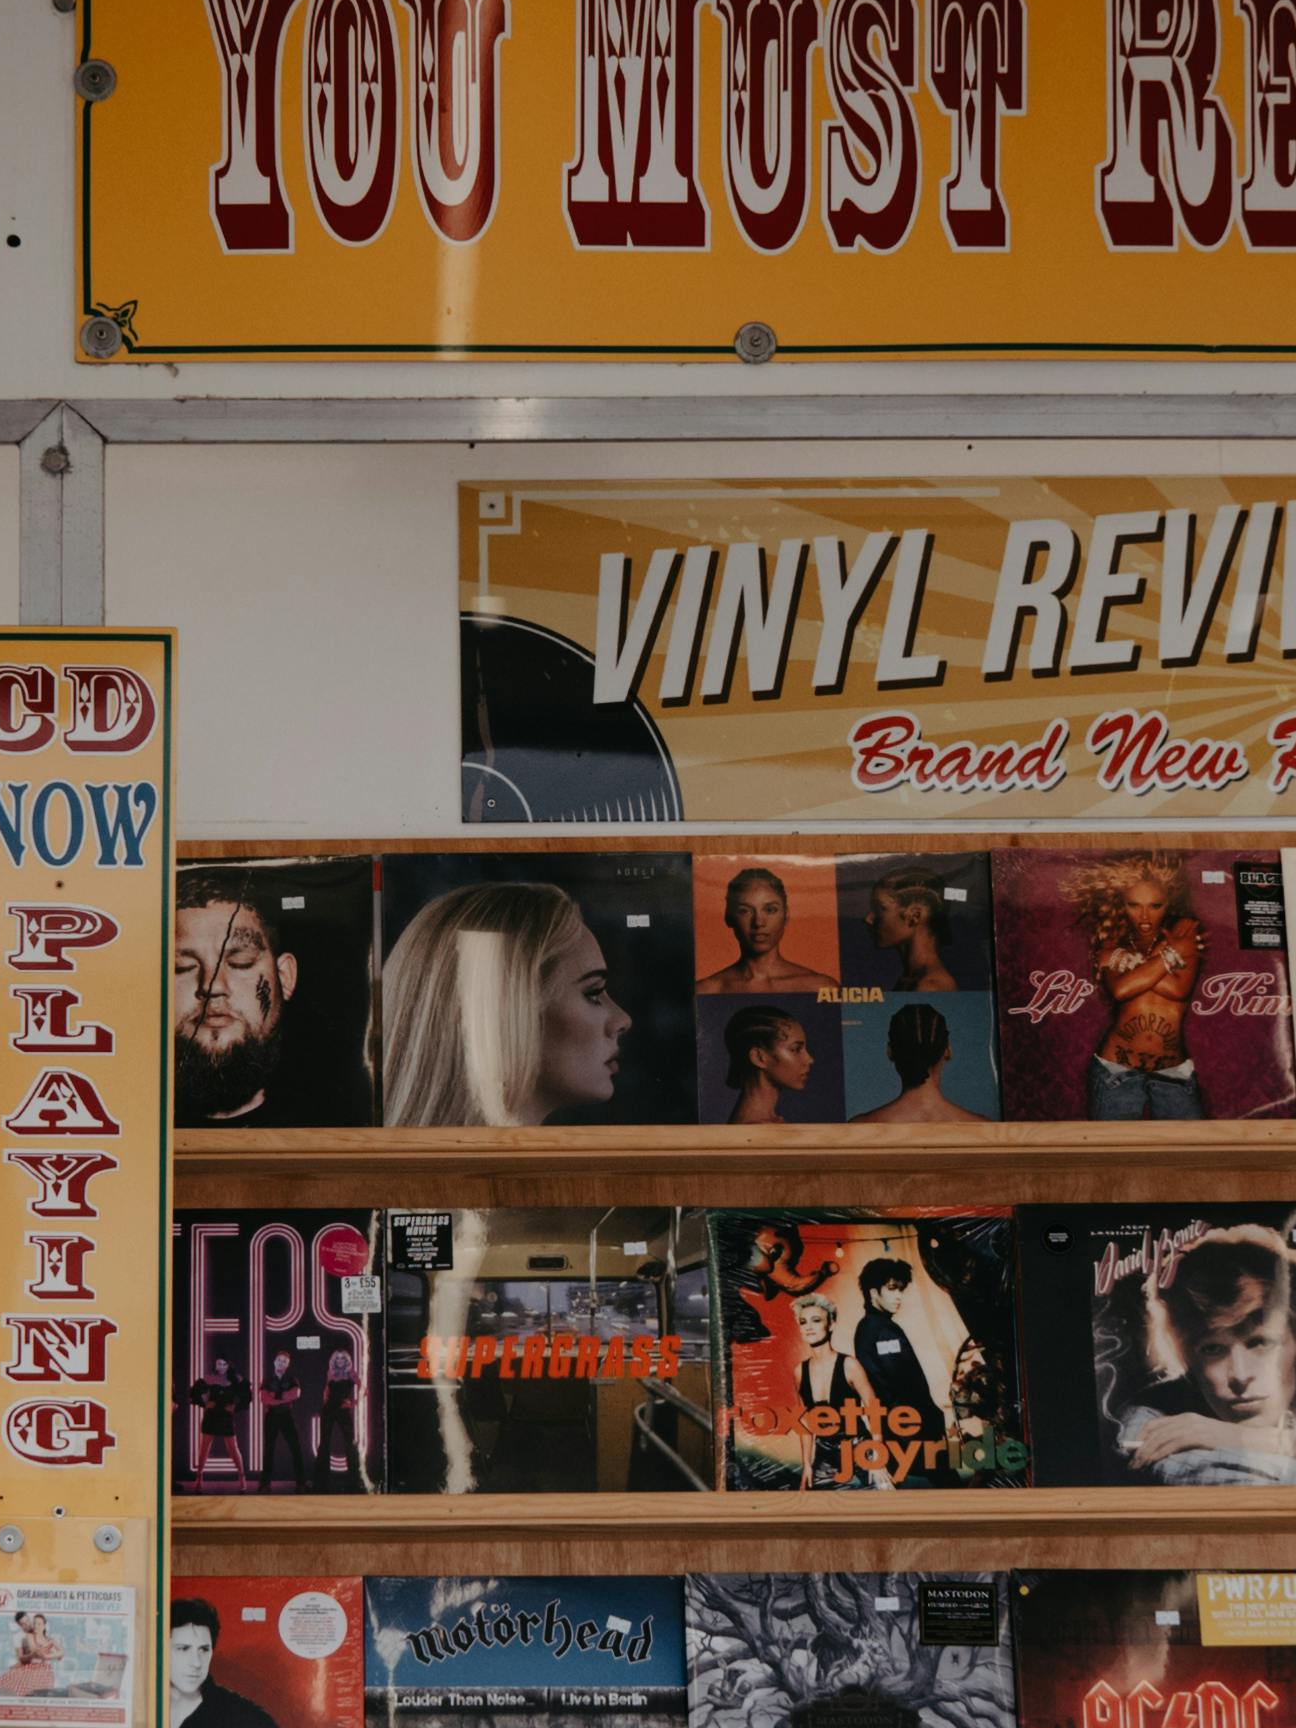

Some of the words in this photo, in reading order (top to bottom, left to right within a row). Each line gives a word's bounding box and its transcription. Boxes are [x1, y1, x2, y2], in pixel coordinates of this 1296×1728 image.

[591, 527, 946, 709] VINYL
[849, 709, 1070, 796] Brand
[1086, 707, 1250, 796] New
[816, 986, 884, 1005] ALICIA
[1191, 971, 1292, 1017] Kim
[1, 900, 122, 1466] PLAYING
[1093, 1231, 1156, 1295] David
[417, 1333, 683, 1380] SUPERGRASS
[715, 1397, 922, 1442] roxette
[837, 1419, 1027, 1485] joyride
[927, 1589, 990, 1601] MASTODON
[561, 1693, 590, 1706] Live
[609, 1693, 648, 1706] Berlin
